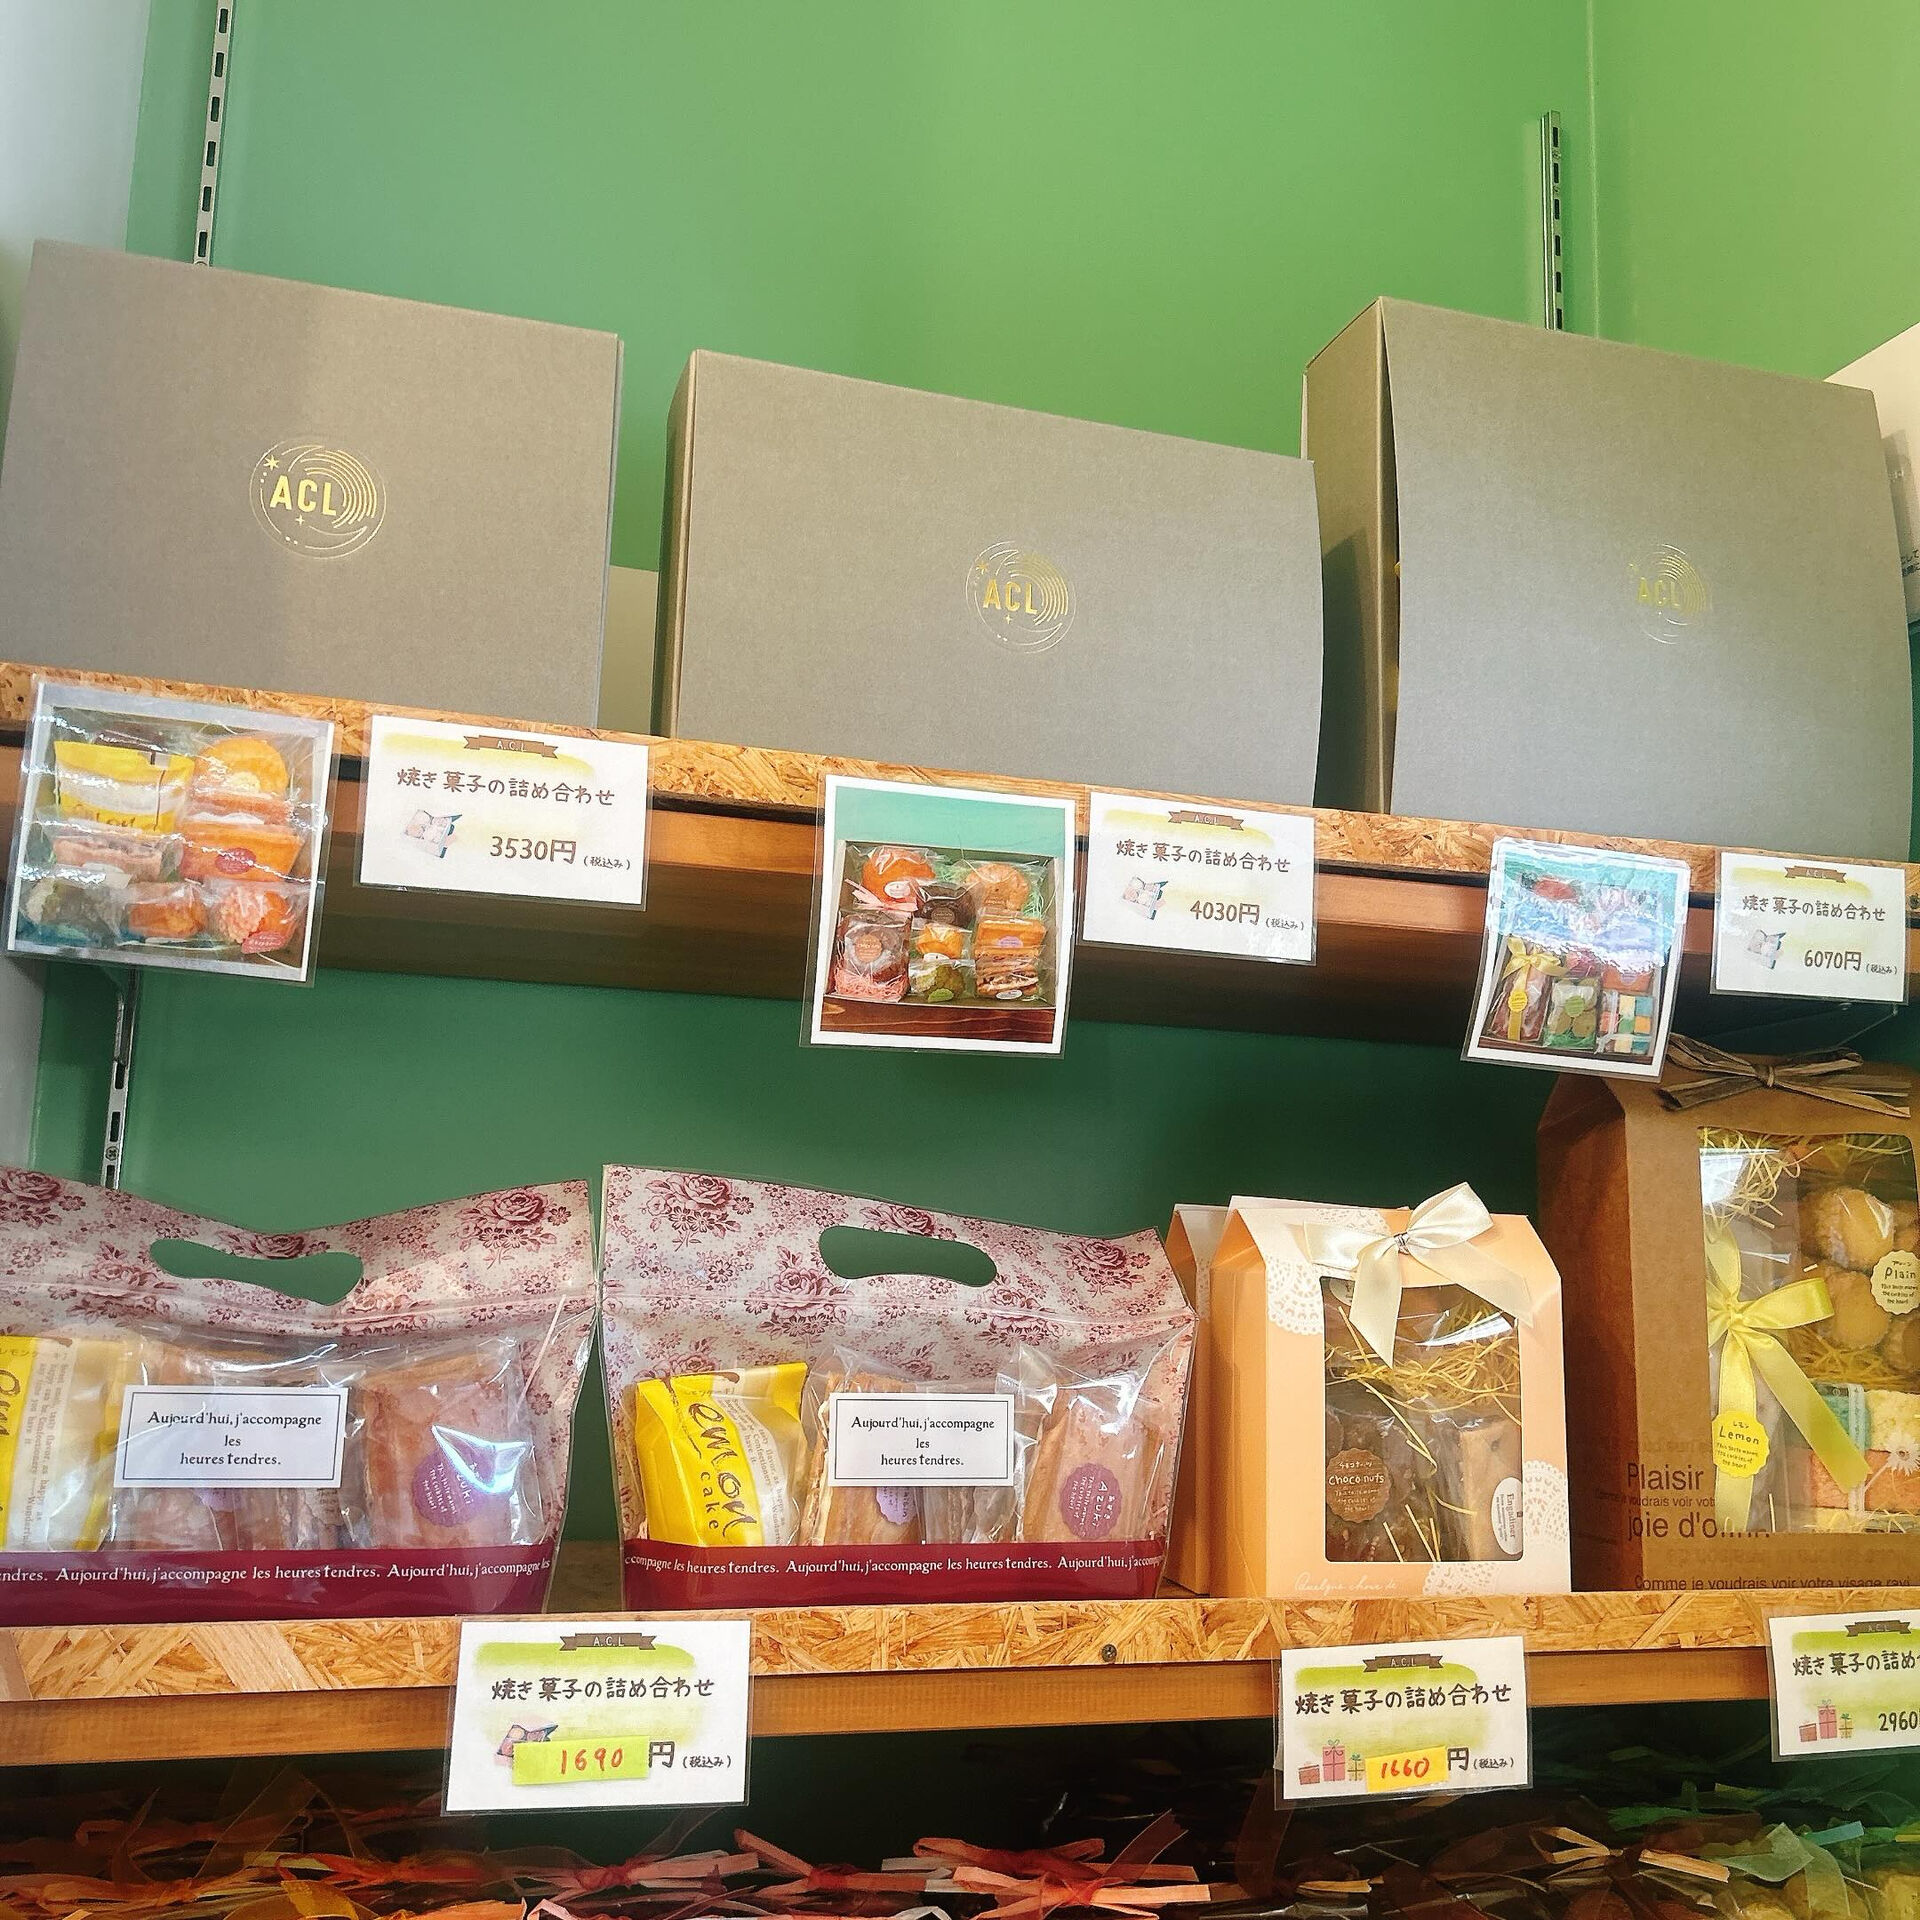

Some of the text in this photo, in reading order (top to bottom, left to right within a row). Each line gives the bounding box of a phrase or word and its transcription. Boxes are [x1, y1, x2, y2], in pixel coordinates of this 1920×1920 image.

[270, 475, 336, 516] ACL
[983, 579, 1038, 615] ACL
[396, 767, 616, 806] 焼き菓子の詰め合わせ
[490, 836, 577, 864] 3530円
[1116, 839, 1291, 873] 焼き菓子の詰め合わせ
[1190, 900, 1260, 926] 4030円
[1742, 894, 1886, 922] 焼き菓子の詰め合わせ
[1804, 950, 1862, 972] 6070円
[1884, 1267, 1916, 1279] Plain
[225, 1435, 242, 1447] les
[916, 1438, 930, 1449] les
[1719, 1425, 1759, 1445] Lemon
[180, 1452, 281, 1465] heures tendres.
[881, 1454, 964, 1466] heures tendres.
[1626, 1462, 1704, 1490] Plaisir
[1091, 1480, 1108, 1527] Azuki
[1673, 1497, 1692, 1507] voir
[1697, 1497, 1716, 1507] vot
[1627, 1512, 1669, 1541] joie
[252, 1566, 271, 1579] les
[275, 1566, 320, 1579] heures
[324, 1565, 381, 1578] tendres.
[674, 1559, 685, 1572] les
[687, 1560, 726, 1574] heures
[728, 1561, 780, 1574] tendres.
[947, 1557, 962, 1570] les
[966, 1557, 1003, 1570] heures
[1005, 1556, 1052, 1570] tendres.
[1634, 1575, 1687, 1590] Comme
[1792, 1650, 1920, 1676] 焼き菓子の詰め
[491, 1675, 715, 1702] 焼き菓子の詰め合わせ
[1295, 1683, 1512, 1715] 焼き菓子の詰め合わせ
[1878, 1710, 1920, 1732] 2960
[559, 1747, 624, 1775] 1690
